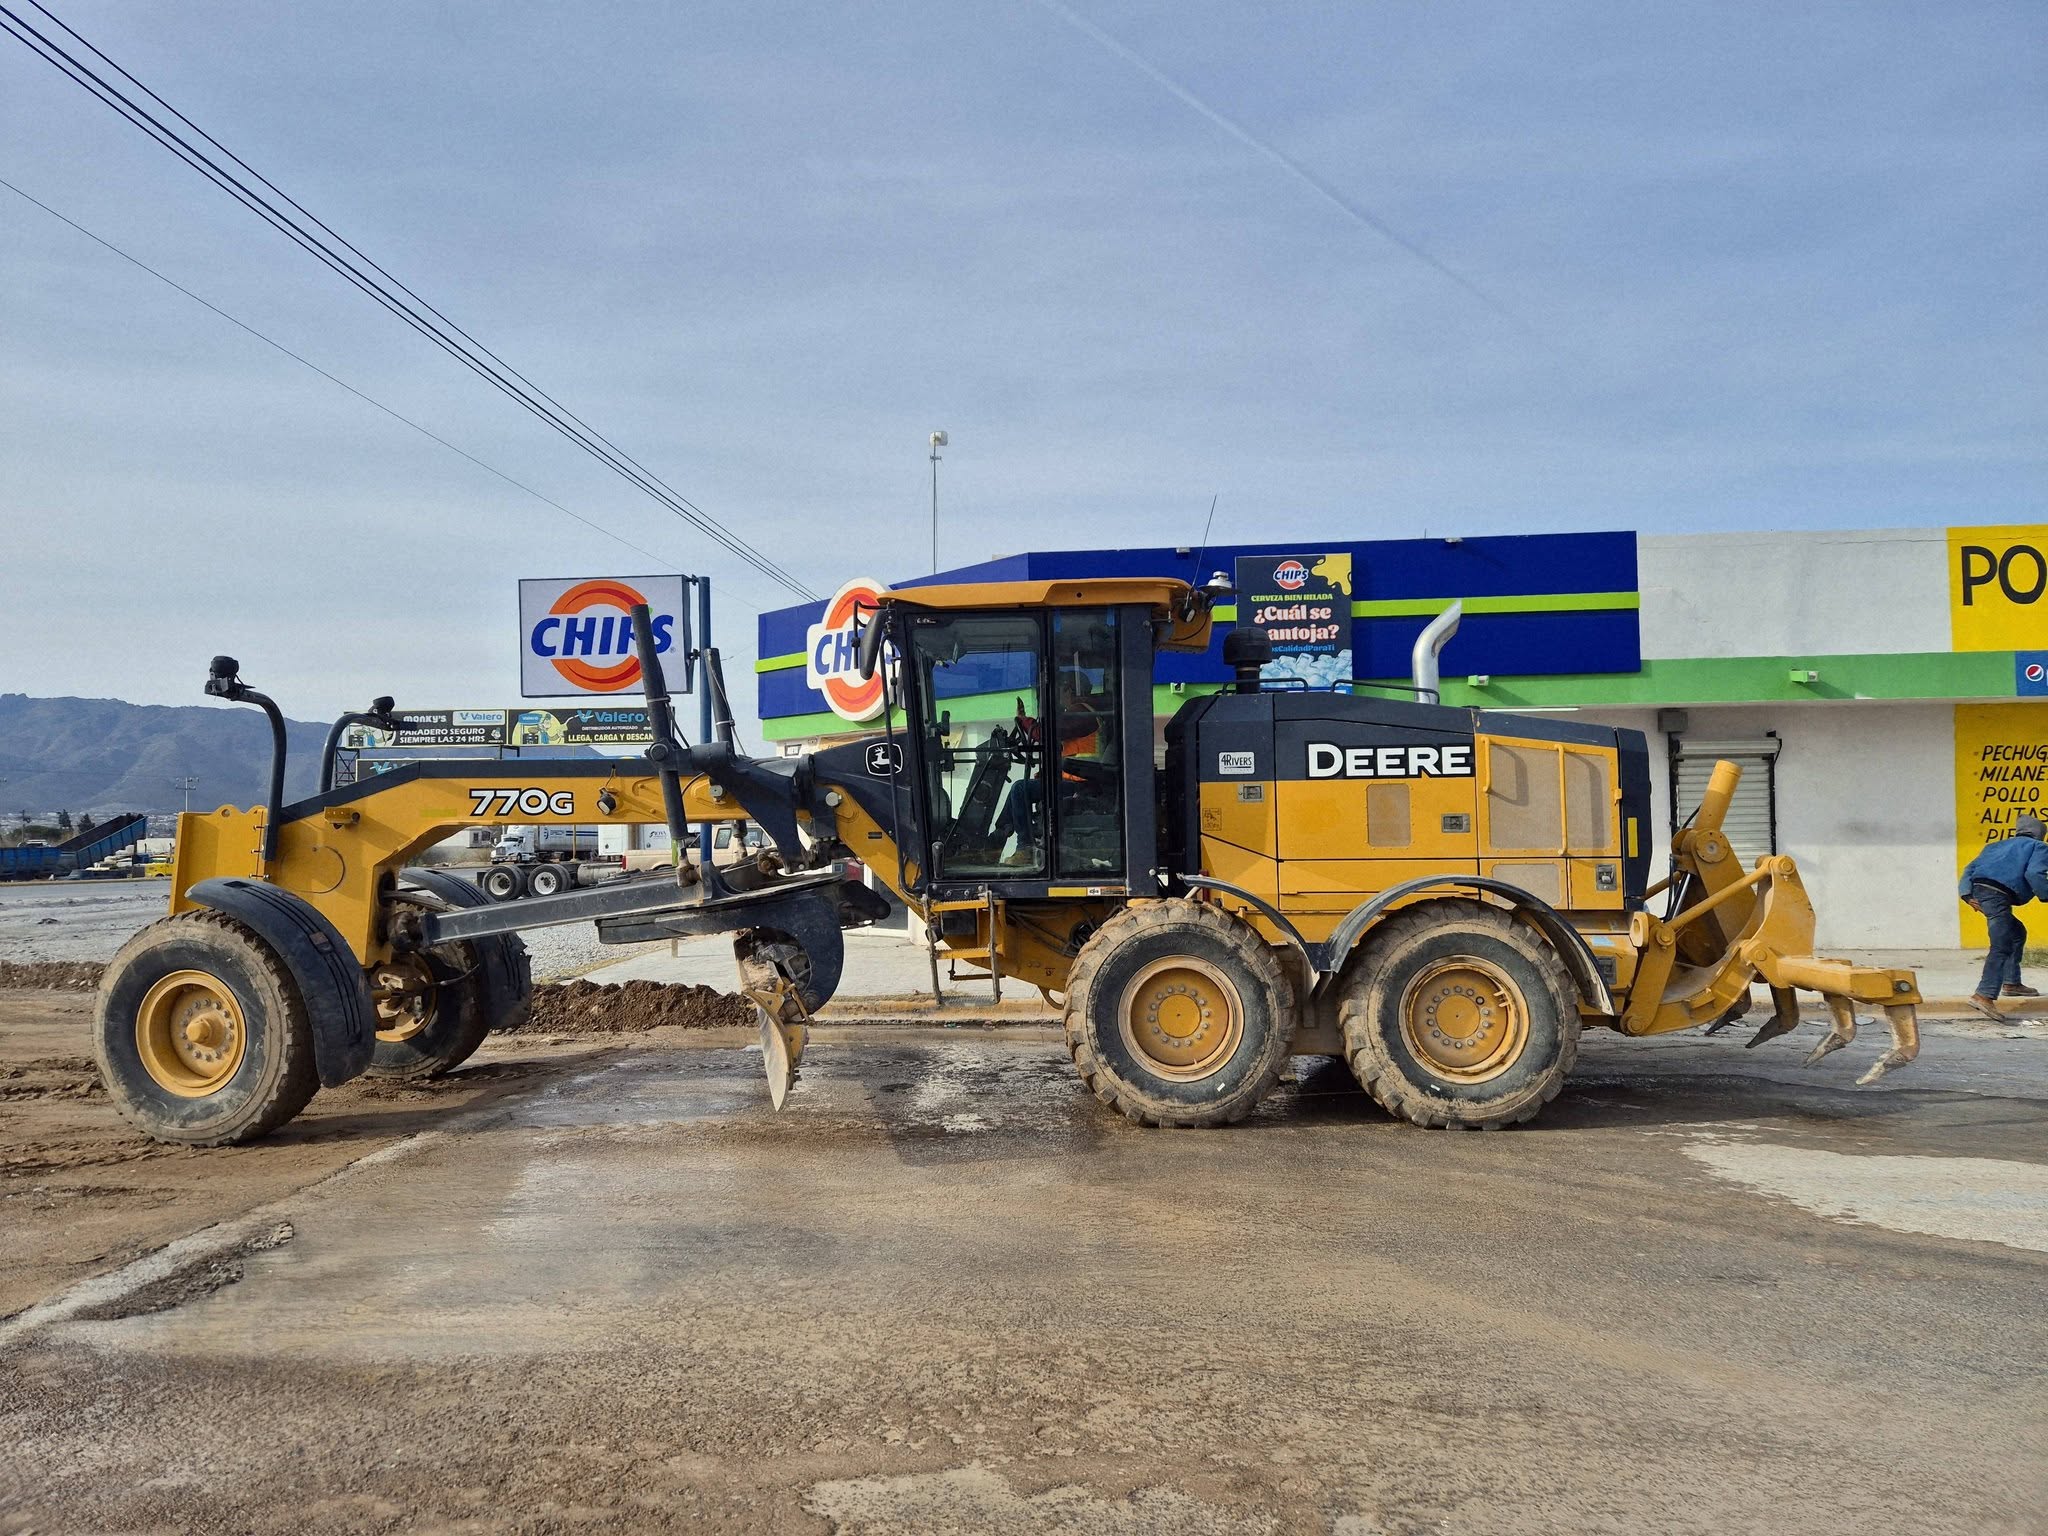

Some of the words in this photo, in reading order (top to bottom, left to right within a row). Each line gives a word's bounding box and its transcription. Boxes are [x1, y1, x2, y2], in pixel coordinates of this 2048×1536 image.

[1274, 569, 1308, 580] CHIPS
[1961, 545, 2047, 606] PO
[1254, 604, 1307, 624] ¿Cuál
[1309, 607, 1332, 620] se
[1267, 624, 1340, 643] antoja?
[1272, 644, 1335, 652] sCalidadParaTi
[472, 712, 503, 721] Valero
[594, 711, 645, 723] Valero
[438, 735, 453, 743] LAS
[468, 735, 485, 743] HRS
[450, 727, 485, 735] SEGURO
[568, 734, 593, 743] LLEGA,
[594, 733, 618, 741] CARGA
[619, 733, 625, 741] Y
[1308, 743, 1471, 777] DEERE
[1981, 744, 2048, 763] PECHUG
[1980, 765, 2048, 782] MILANE
[469, 787, 574, 816] 770G
[1982, 786, 2040, 803] POLLO
